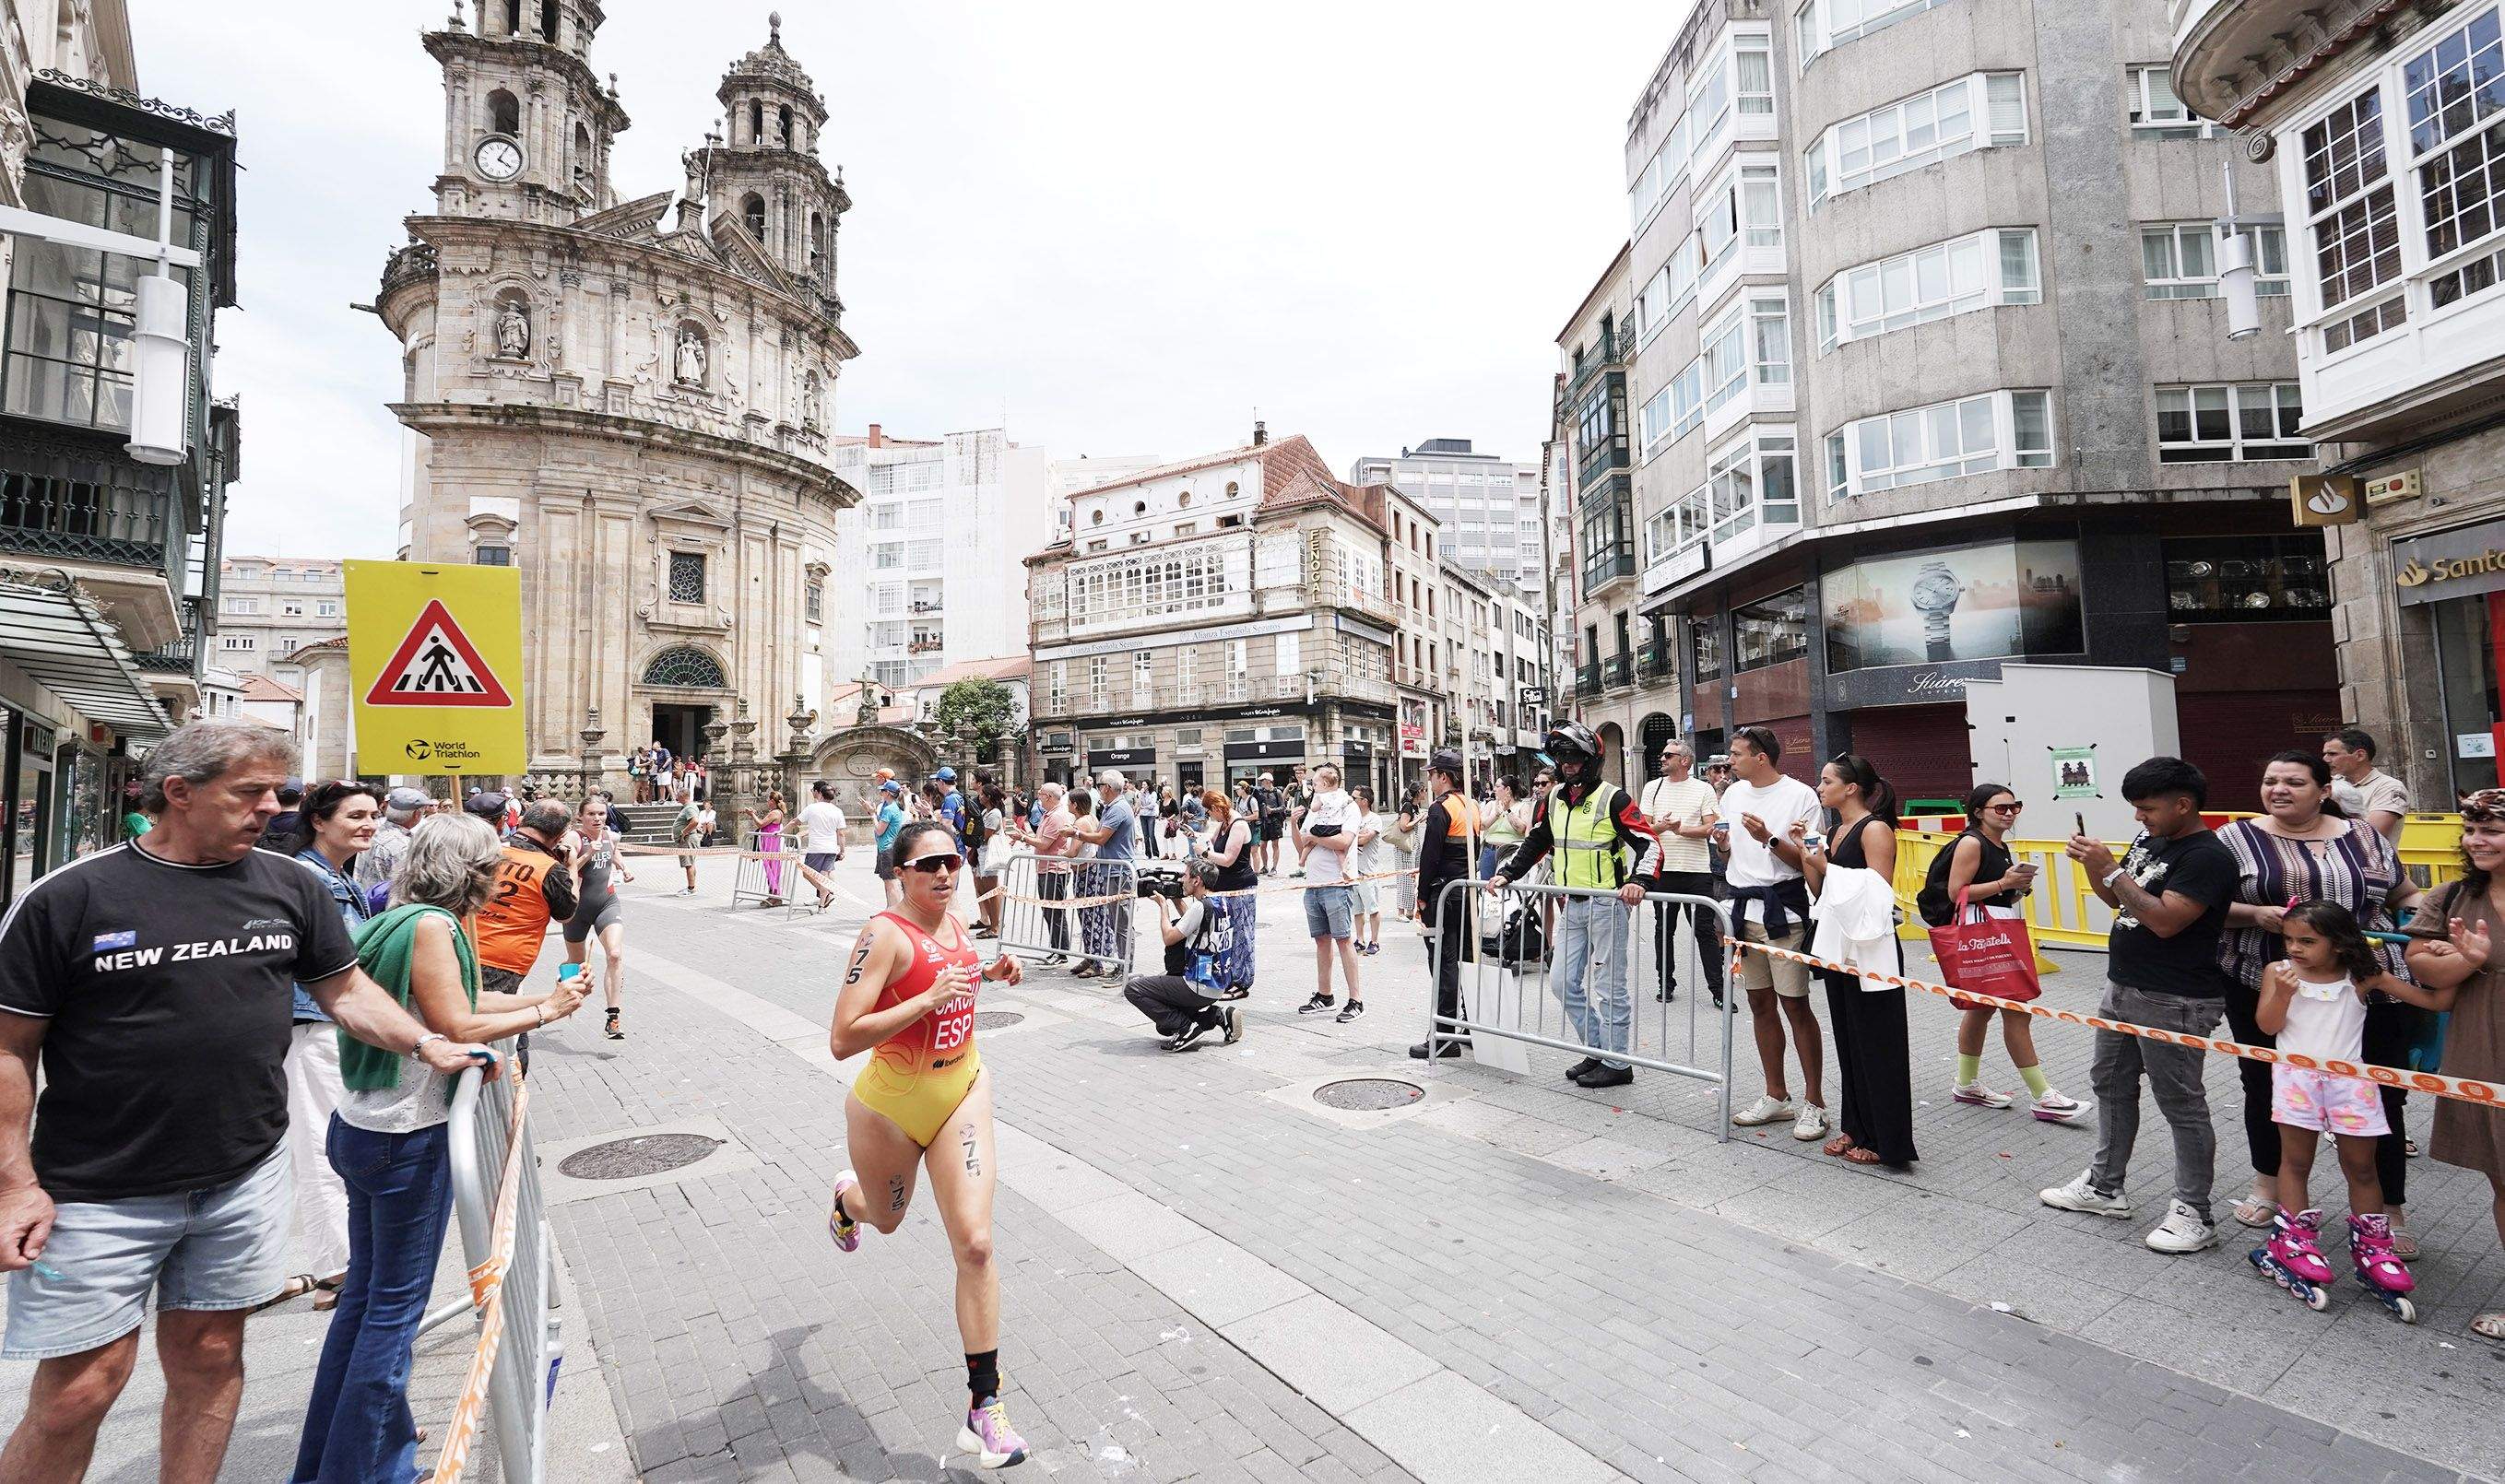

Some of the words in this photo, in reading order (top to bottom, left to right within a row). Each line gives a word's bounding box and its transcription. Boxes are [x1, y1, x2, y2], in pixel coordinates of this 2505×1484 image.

[1310, 529, 1321, 604] FENOGAL
[1192, 630, 1218, 641] Alianza
[1220, 626, 1250, 638] Española
[1252, 622, 1282, 634] Seguros
[433, 750, 480, 759] Triathlon
[593, 860, 609, 870] AUT
[94, 947, 164, 973] NEW
[171, 934, 292, 962] ZEALAND
[845, 948, 870, 985] 75
[934, 1017, 972, 1050] ESP
[963, 1140, 981, 1177] 75
[892, 1185, 905, 1211] 75
